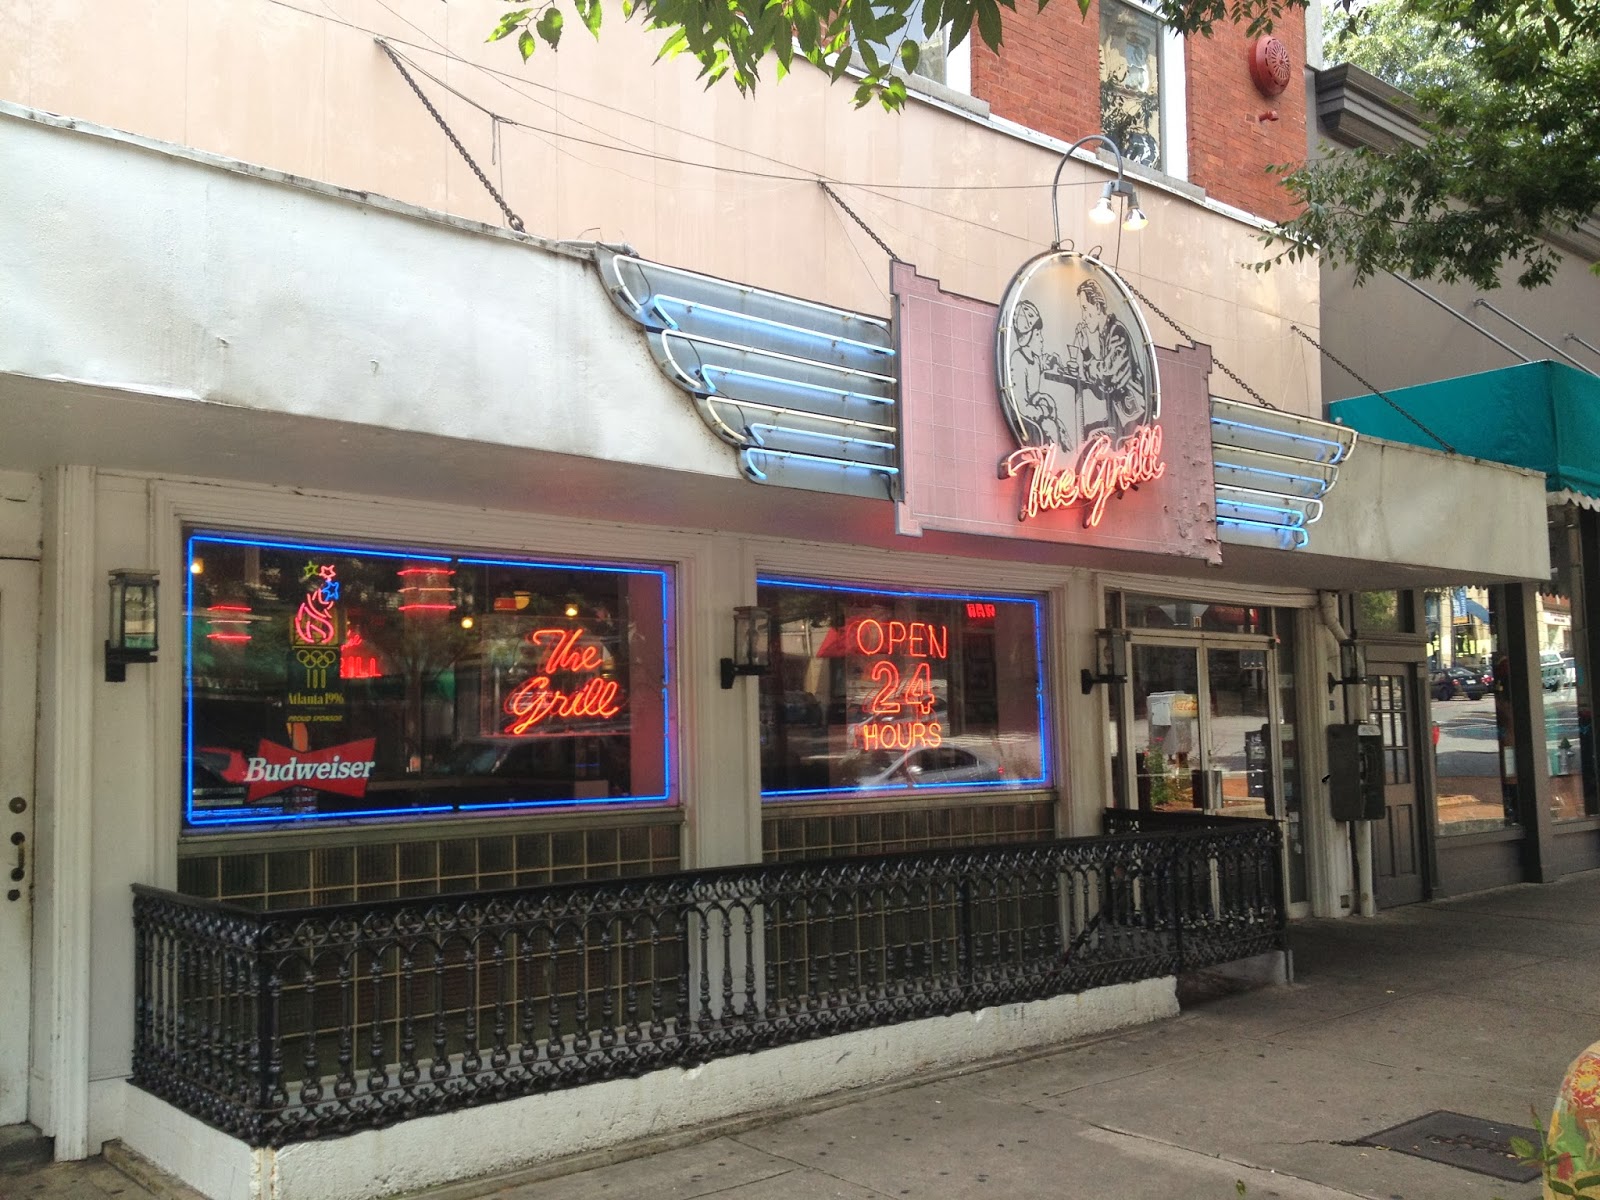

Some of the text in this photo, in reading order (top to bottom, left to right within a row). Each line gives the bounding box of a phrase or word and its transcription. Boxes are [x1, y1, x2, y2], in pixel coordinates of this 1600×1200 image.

[1007, 425, 1168, 527] The Grill
[532, 628, 603, 674] The
[857, 618, 947, 659] OPEN
[513, 676, 620, 735] Grill
[871, 660, 935, 715] 24
[863, 722, 942, 751] HOURS
[243, 755, 376, 782] Budweiser
